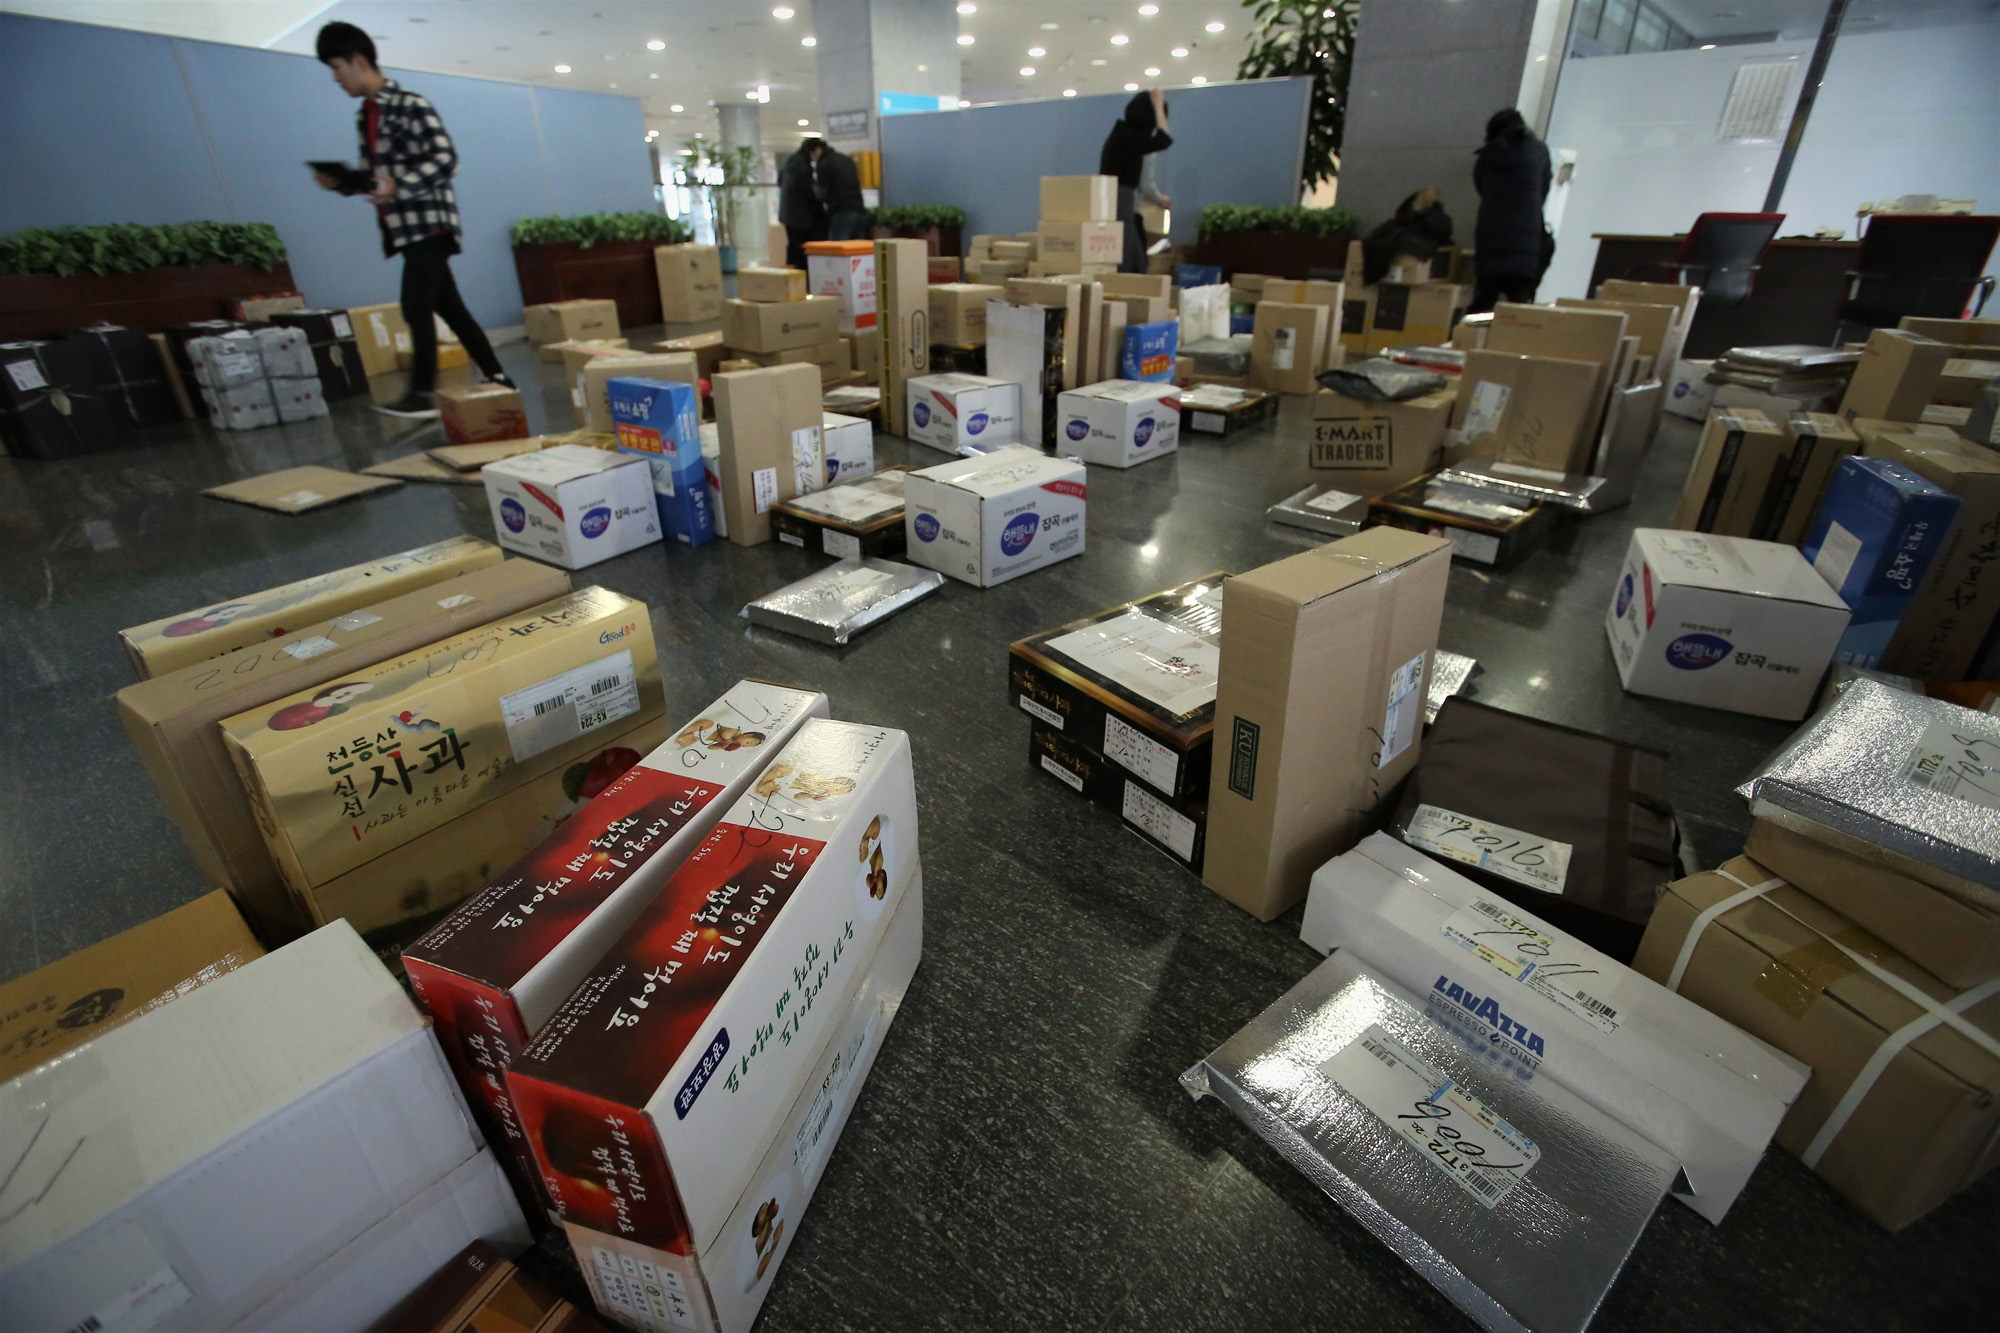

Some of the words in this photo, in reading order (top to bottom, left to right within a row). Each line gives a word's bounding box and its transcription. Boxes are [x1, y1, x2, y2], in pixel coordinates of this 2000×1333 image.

[1315, 443, 1384, 461] TRADERS
[1042, 514, 1060, 532] 잡곡
[1886, 553, 1914, 590] 쇼핑
[1734, 651, 1767, 669] 잡곡
[580, 707, 608, 730] K5-224
[326, 727, 402, 775] 천등산
[1239, 727, 1254, 756] KU
[368, 728, 471, 800] 사과
[1241, 757, 1250, 790] KONKUK
[333, 774, 367, 819] 신선
[364, 804, 409, 834] 사과는
[415, 773, 471, 807] 아름다운
[669, 786, 708, 815] 우리
[588, 818, 638, 848] 껍질
[1450, 816, 1472, 828] T72
[589, 819, 668, 881] 서영이도
[692, 848, 711, 860] 5kg
[770, 843, 810, 879] 우리
[492, 872, 569, 932] 먹어요
[690, 886, 740, 922] 껍질
[703, 884, 775, 964] 서영이도
[834, 921, 853, 963] 우리
[1510, 919, 1538, 938] T72
[794, 944, 820, 988] 껍질
[474, 994, 503, 1032] 우리
[606, 961, 680, 1030] 먹어요
[779, 962, 828, 1046] 서영이도
[564, 1019, 578, 1034] 사과
[1429, 994, 1486, 1036] ESPRESSO
[1501, 1041, 1540, 1070] POINT
[1433, 974, 1544, 1059] LAVAZZA
[541, 1037, 562, 1061] 이야기
[723, 1023, 773, 1093] 먹어요
[680, 1043, 724, 1108] 냉장보관
[495, 1095, 522, 1139] 먹어요
[605, 1115, 629, 1145] 우리
[620, 1148, 646, 1200] 서영이도
[1428, 1139, 1458, 1169] T72
[592, 1148, 617, 1174] 껍질
[611, 1197, 634, 1232] 먹어요
